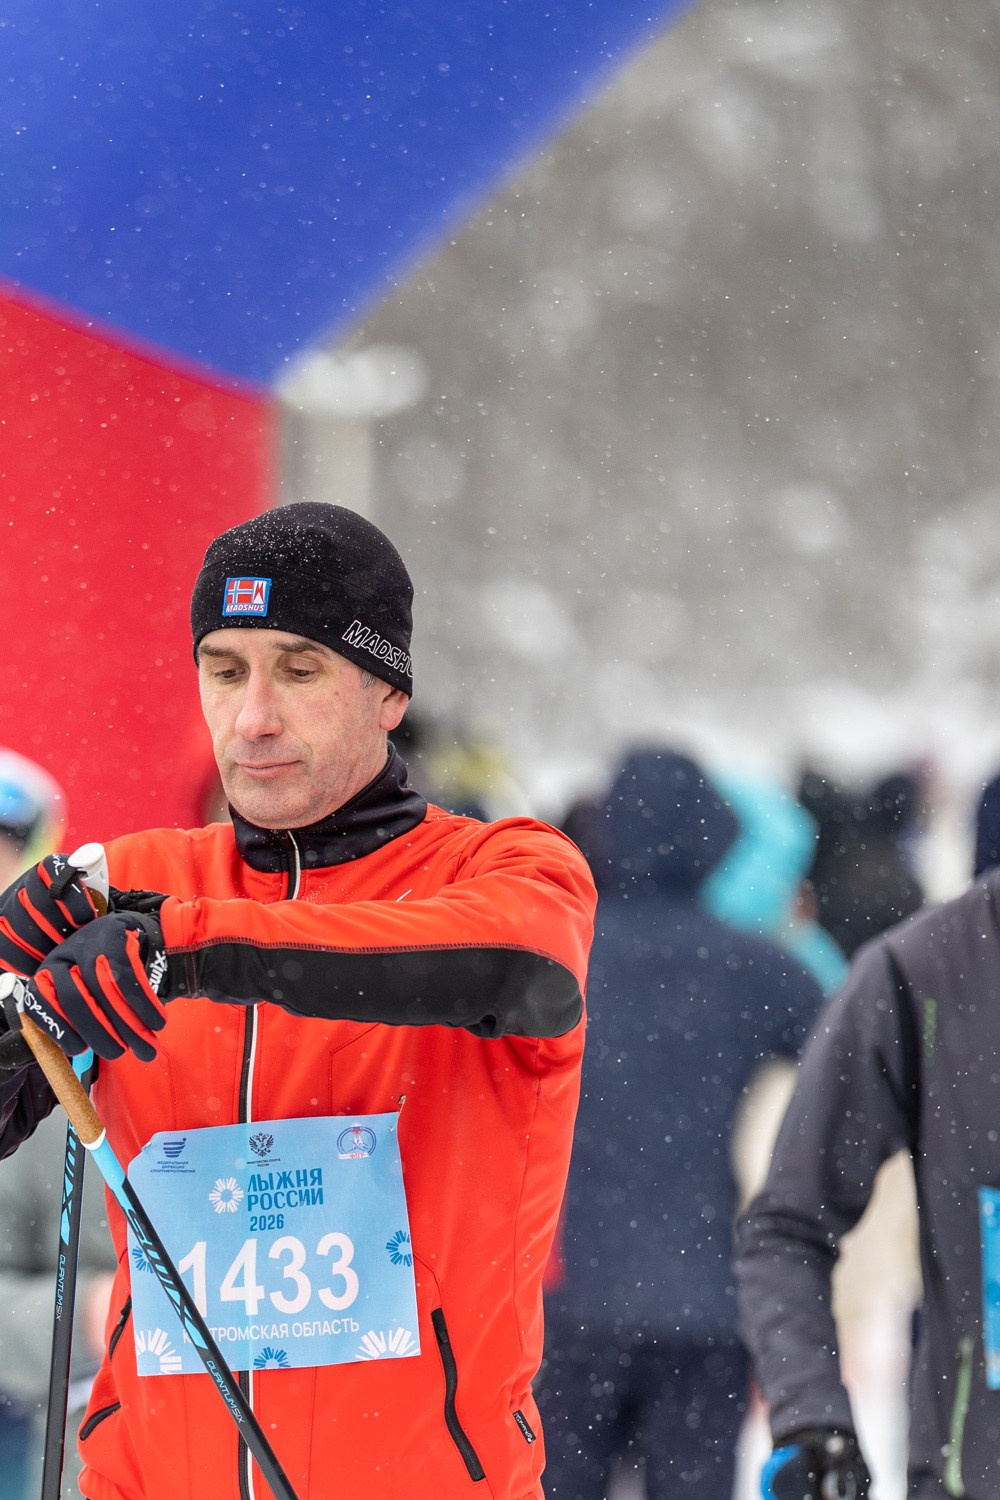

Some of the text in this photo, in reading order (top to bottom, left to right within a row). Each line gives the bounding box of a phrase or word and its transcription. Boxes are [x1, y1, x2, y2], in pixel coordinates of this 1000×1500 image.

[226, 604, 264, 613] MADSHUS
[247, 1167, 323, 1193] ЛЫЖНЯ
[247, 1187, 324, 1212] РОССИИ
[249, 1213, 285, 1232] 2026
[178, 1231, 360, 1319] 1433
[291, 1317, 360, 1338] ОБЛАСТЬ
